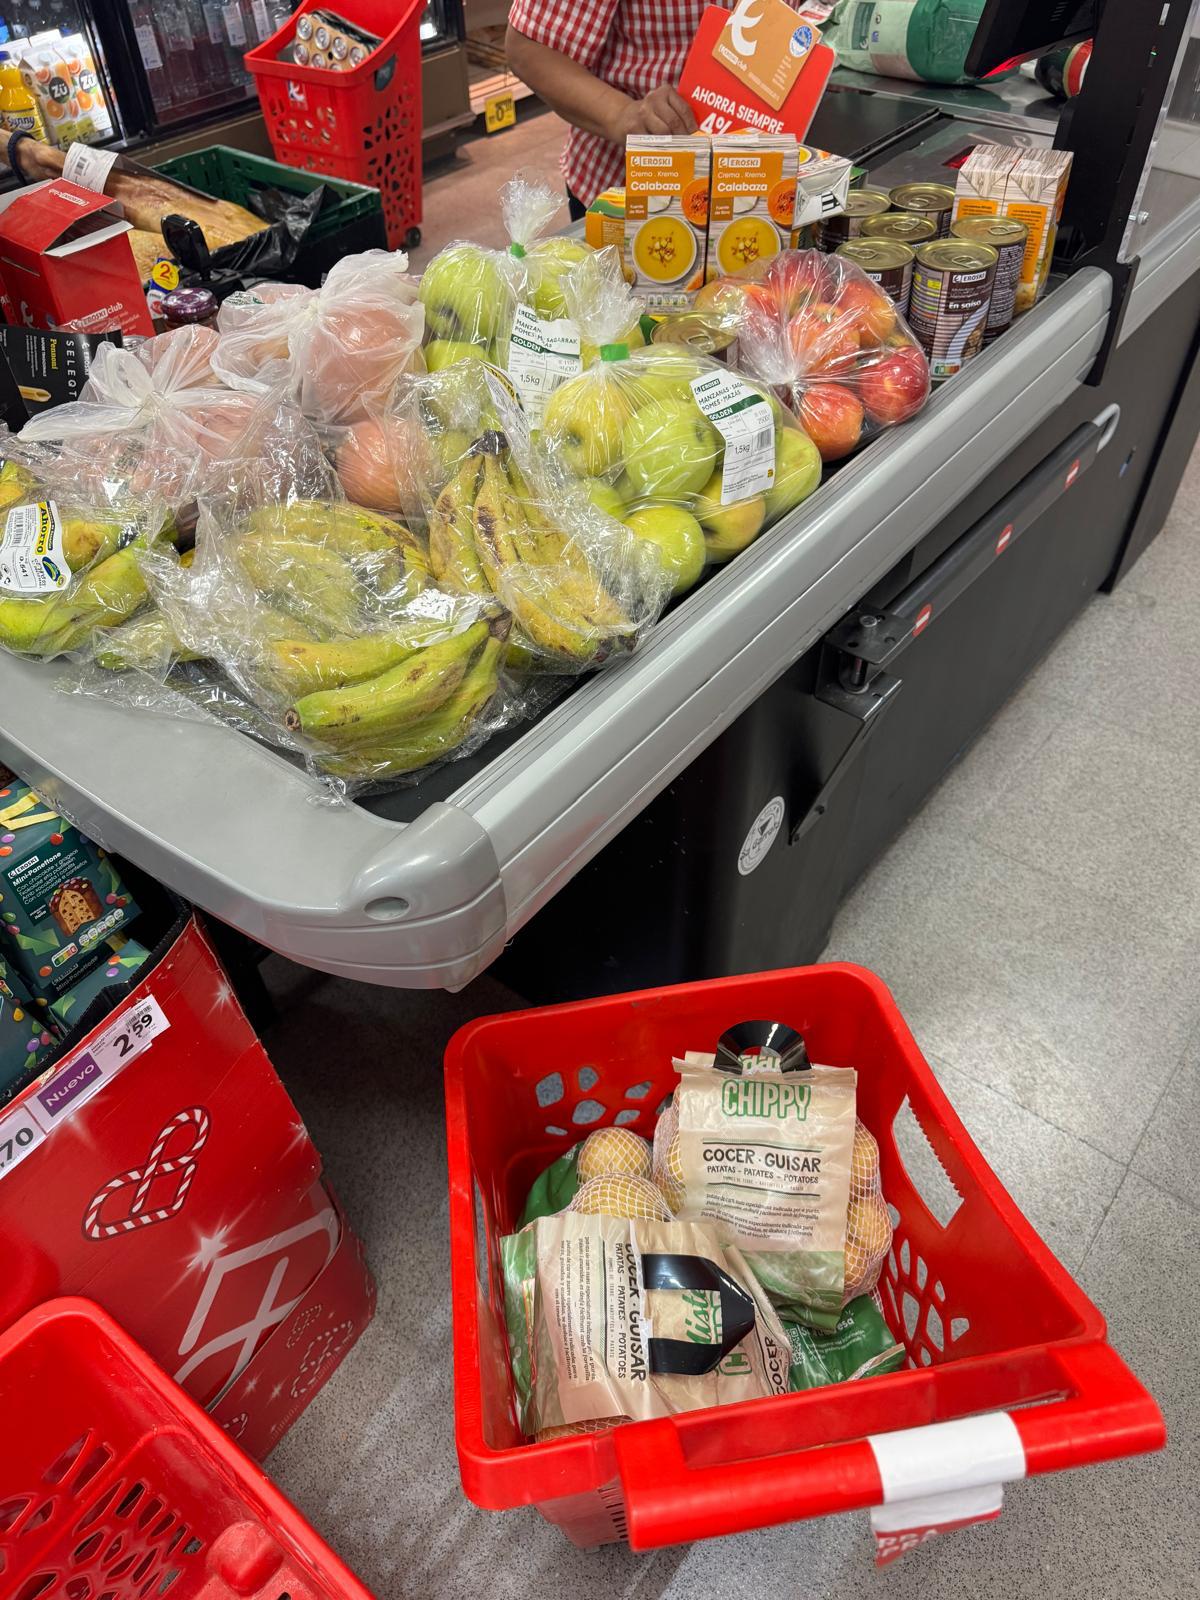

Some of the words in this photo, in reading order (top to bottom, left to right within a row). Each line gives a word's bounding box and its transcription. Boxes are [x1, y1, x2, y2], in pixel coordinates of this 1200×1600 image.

[52, 84, 68, 98] Zü
[691, 86, 736, 116] AHORRA
[736, 105, 784, 134] SIEMPRE
[642, 157, 672, 166] EROSKI
[630, 181, 681, 190] Calabaza
[717, 182, 768, 192] Calabaza
[963, 272, 986, 282] EROSKI
[82, 309, 108, 326] EROSKI
[108, 302, 123, 314] club
[961, 300, 981, 309] salsa
[515, 326, 534, 337] POMES
[513, 336, 540, 352] GOLDEN
[66, 340, 77, 397] SELEQT
[520, 374, 540, 384] 1,5kg
[699, 386, 730, 405] MANZANAS
[702, 399, 720, 410] POMES
[709, 407, 733, 420] GOLDEN
[735, 444, 750, 454] 1,5kg
[37, 508, 48, 553] Ahorro
[13, 852, 62, 886] Mini-Panettone
[17, 856, 37, 872] EROSKI
[17, 883, 28, 892] Con
[29, 866, 54, 886] chocolate
[24, 896, 36, 905] Con
[37, 878, 61, 898] chocolate
[46, 1064, 94, 1107] Nuevo
[722, 1080, 811, 1121] CHIPPY
[703, 1149, 755, 1164] COCER
[765, 1153, 821, 1173] GUISAR
[744, 1168, 774, 1179] PATATES
[784, 1174, 818, 1184] POTATOES
[616, 1243, 625, 1274] PATATAS
[618, 1332, 626, 1378] POTATOES
[629, 1310, 646, 1382] GUISAR
[765, 1337, 786, 1395] COCER
